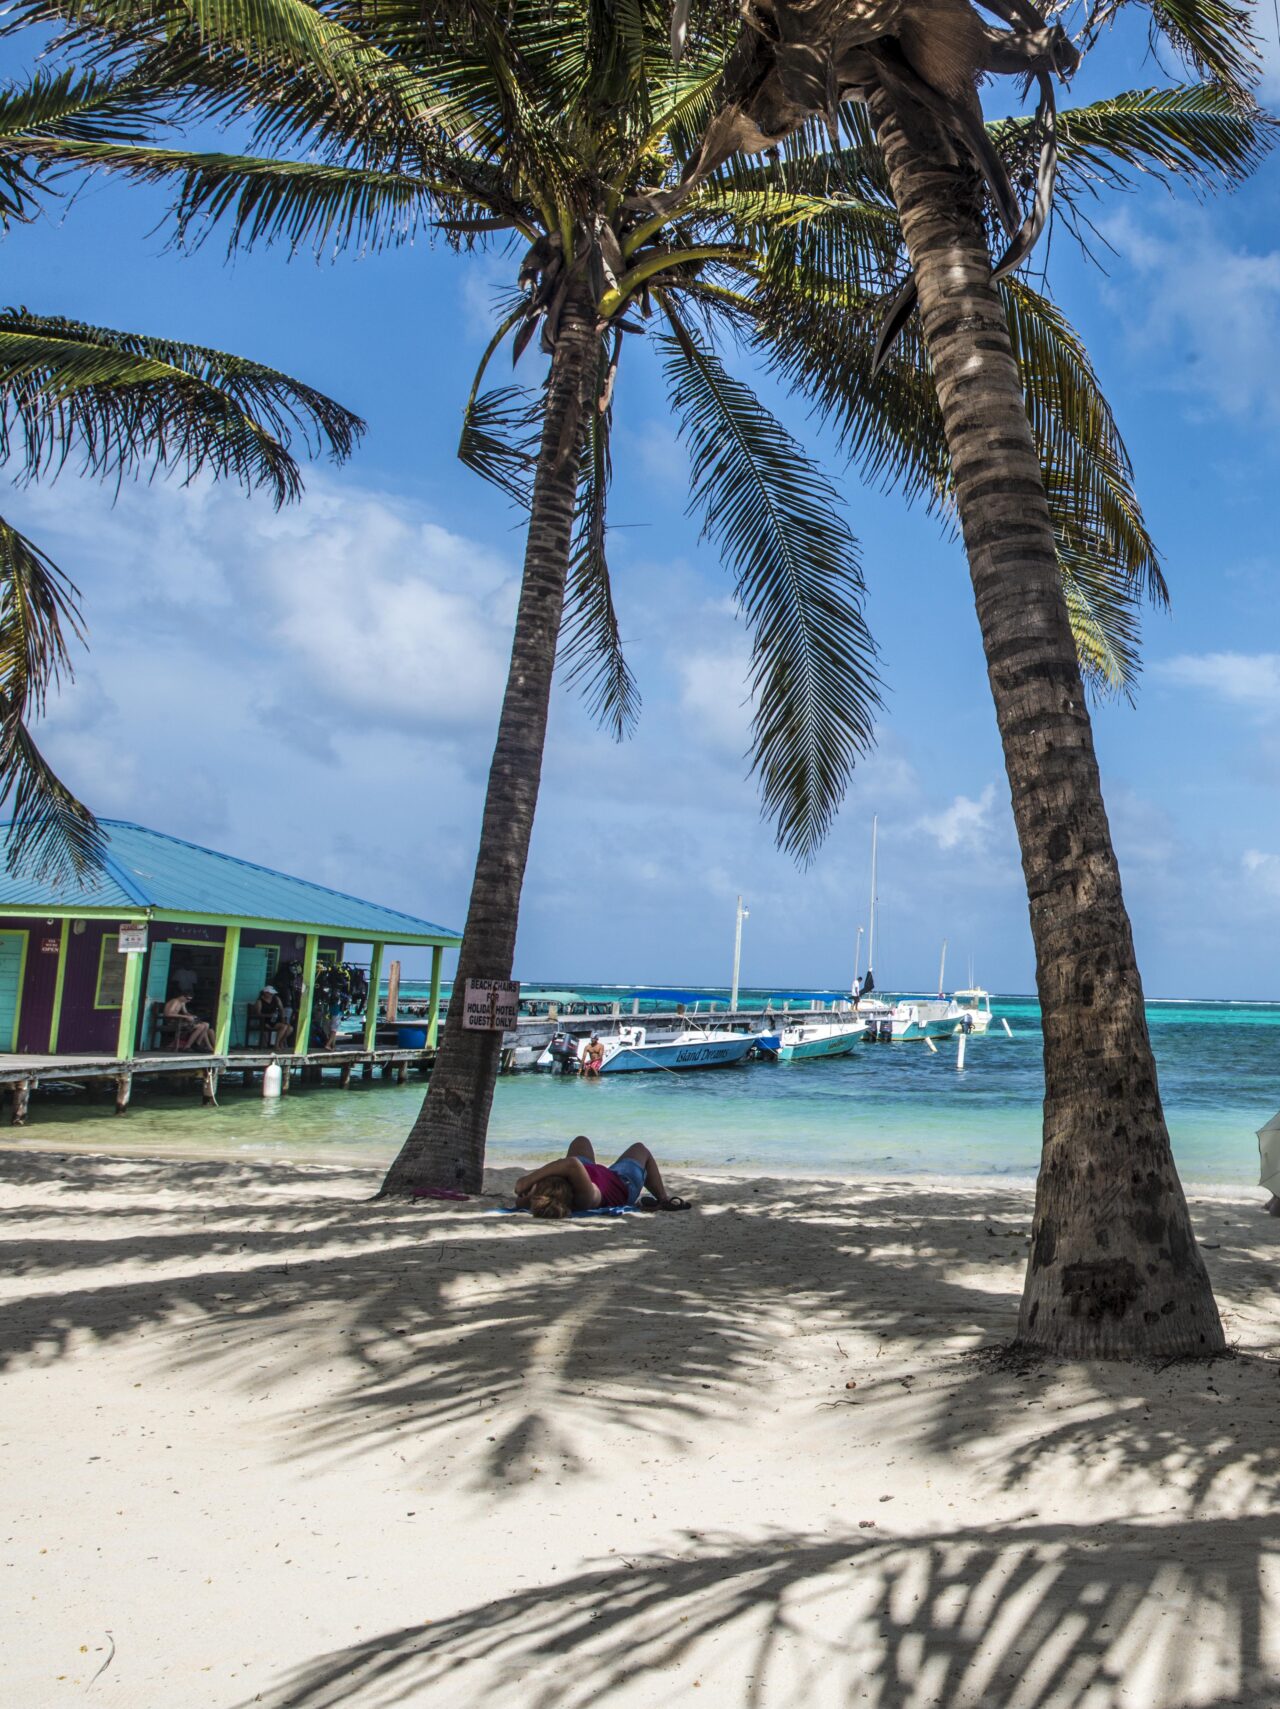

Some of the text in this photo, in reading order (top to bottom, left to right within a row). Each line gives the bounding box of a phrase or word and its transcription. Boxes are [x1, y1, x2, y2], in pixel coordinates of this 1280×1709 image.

[470, 980, 517, 992] BEACH CHAIRS
[486, 992, 500, 1002] FOR
[467, 1003, 516, 1016] HOLIDA HOTEL
[495, 1017, 513, 1028] ONLY
[676, 1048, 728, 1062] Island Dreams
